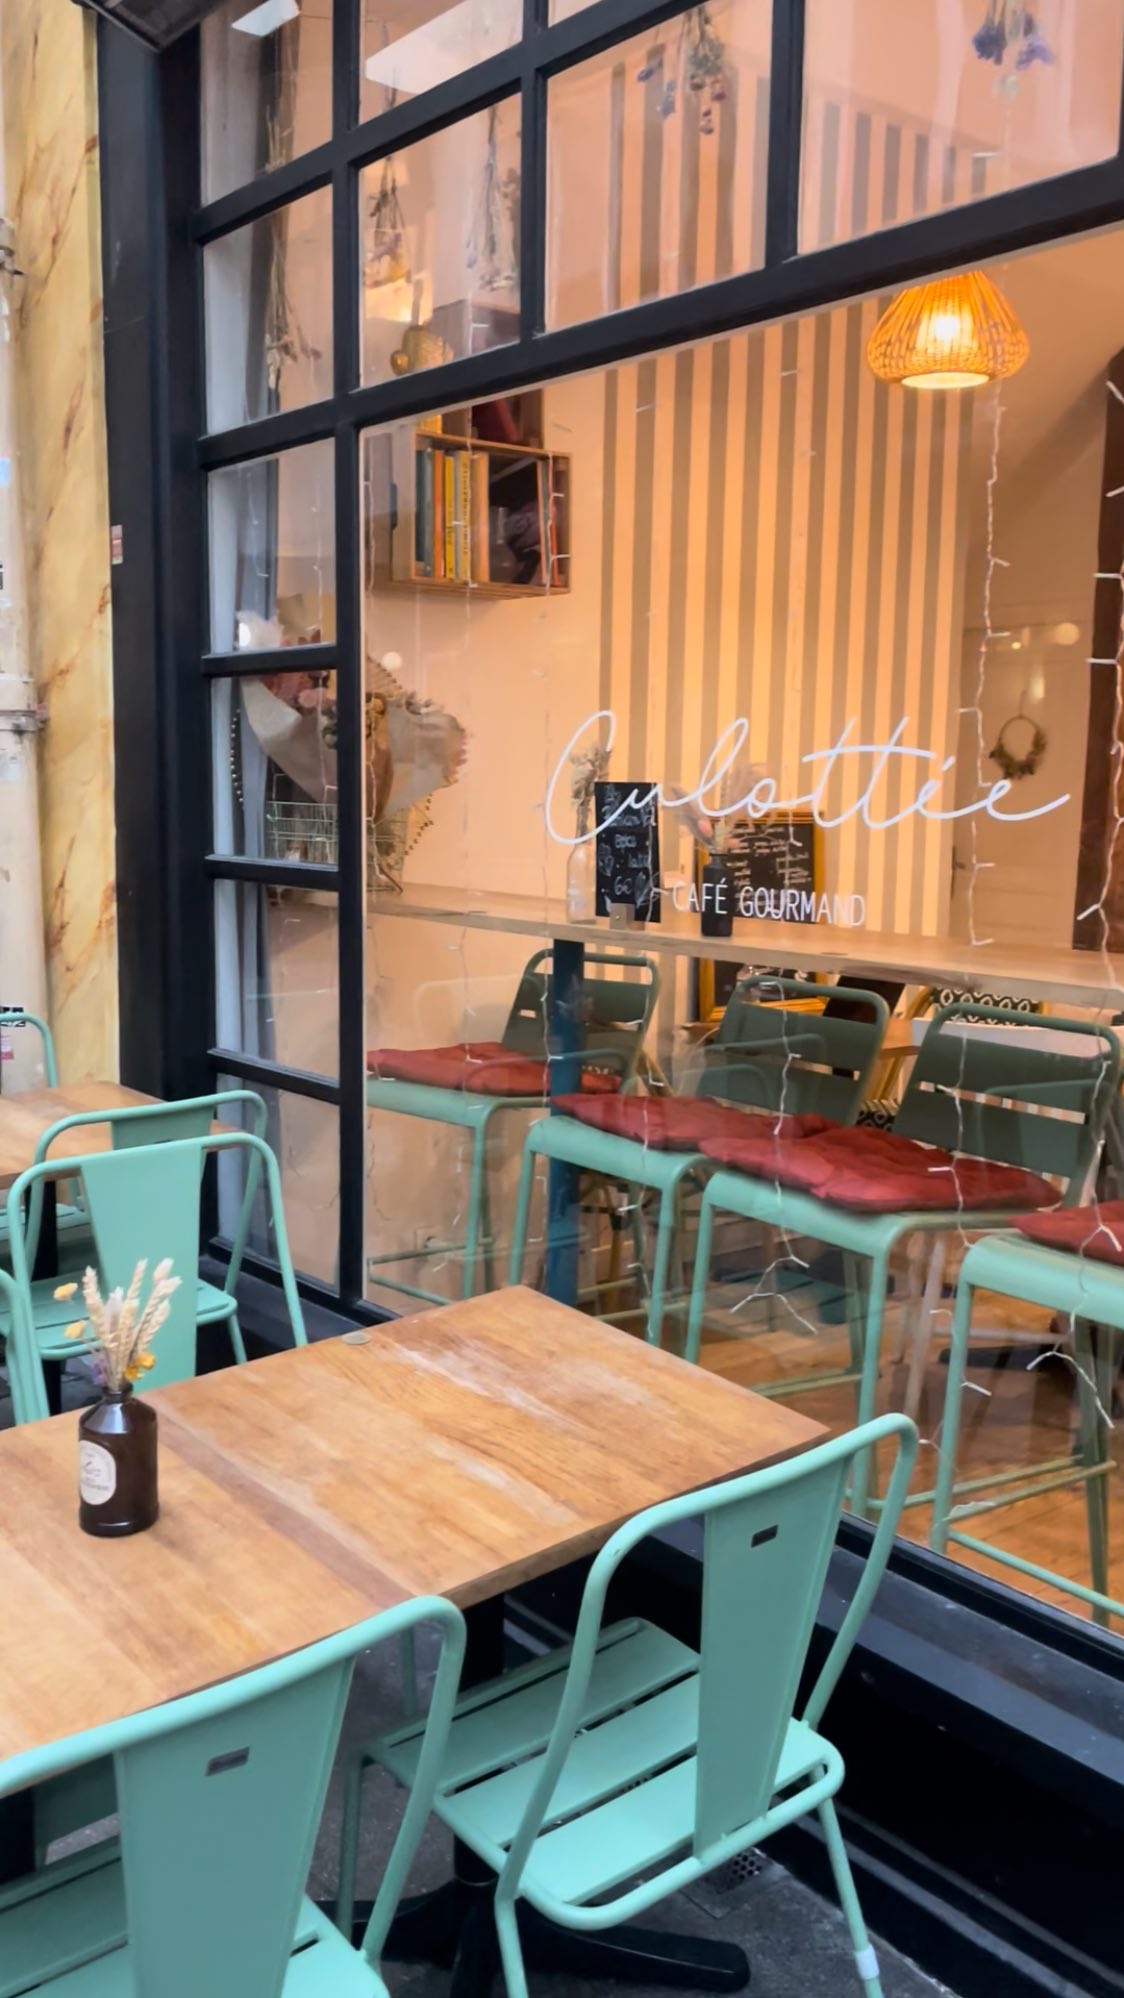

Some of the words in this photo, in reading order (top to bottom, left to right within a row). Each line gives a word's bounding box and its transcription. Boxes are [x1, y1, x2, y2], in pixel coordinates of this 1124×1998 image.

[545, 710, 1071, 845] Culottée
[672, 878, 729, 915] CAFÉ
[740, 886, 866, 927] GOURMAND
